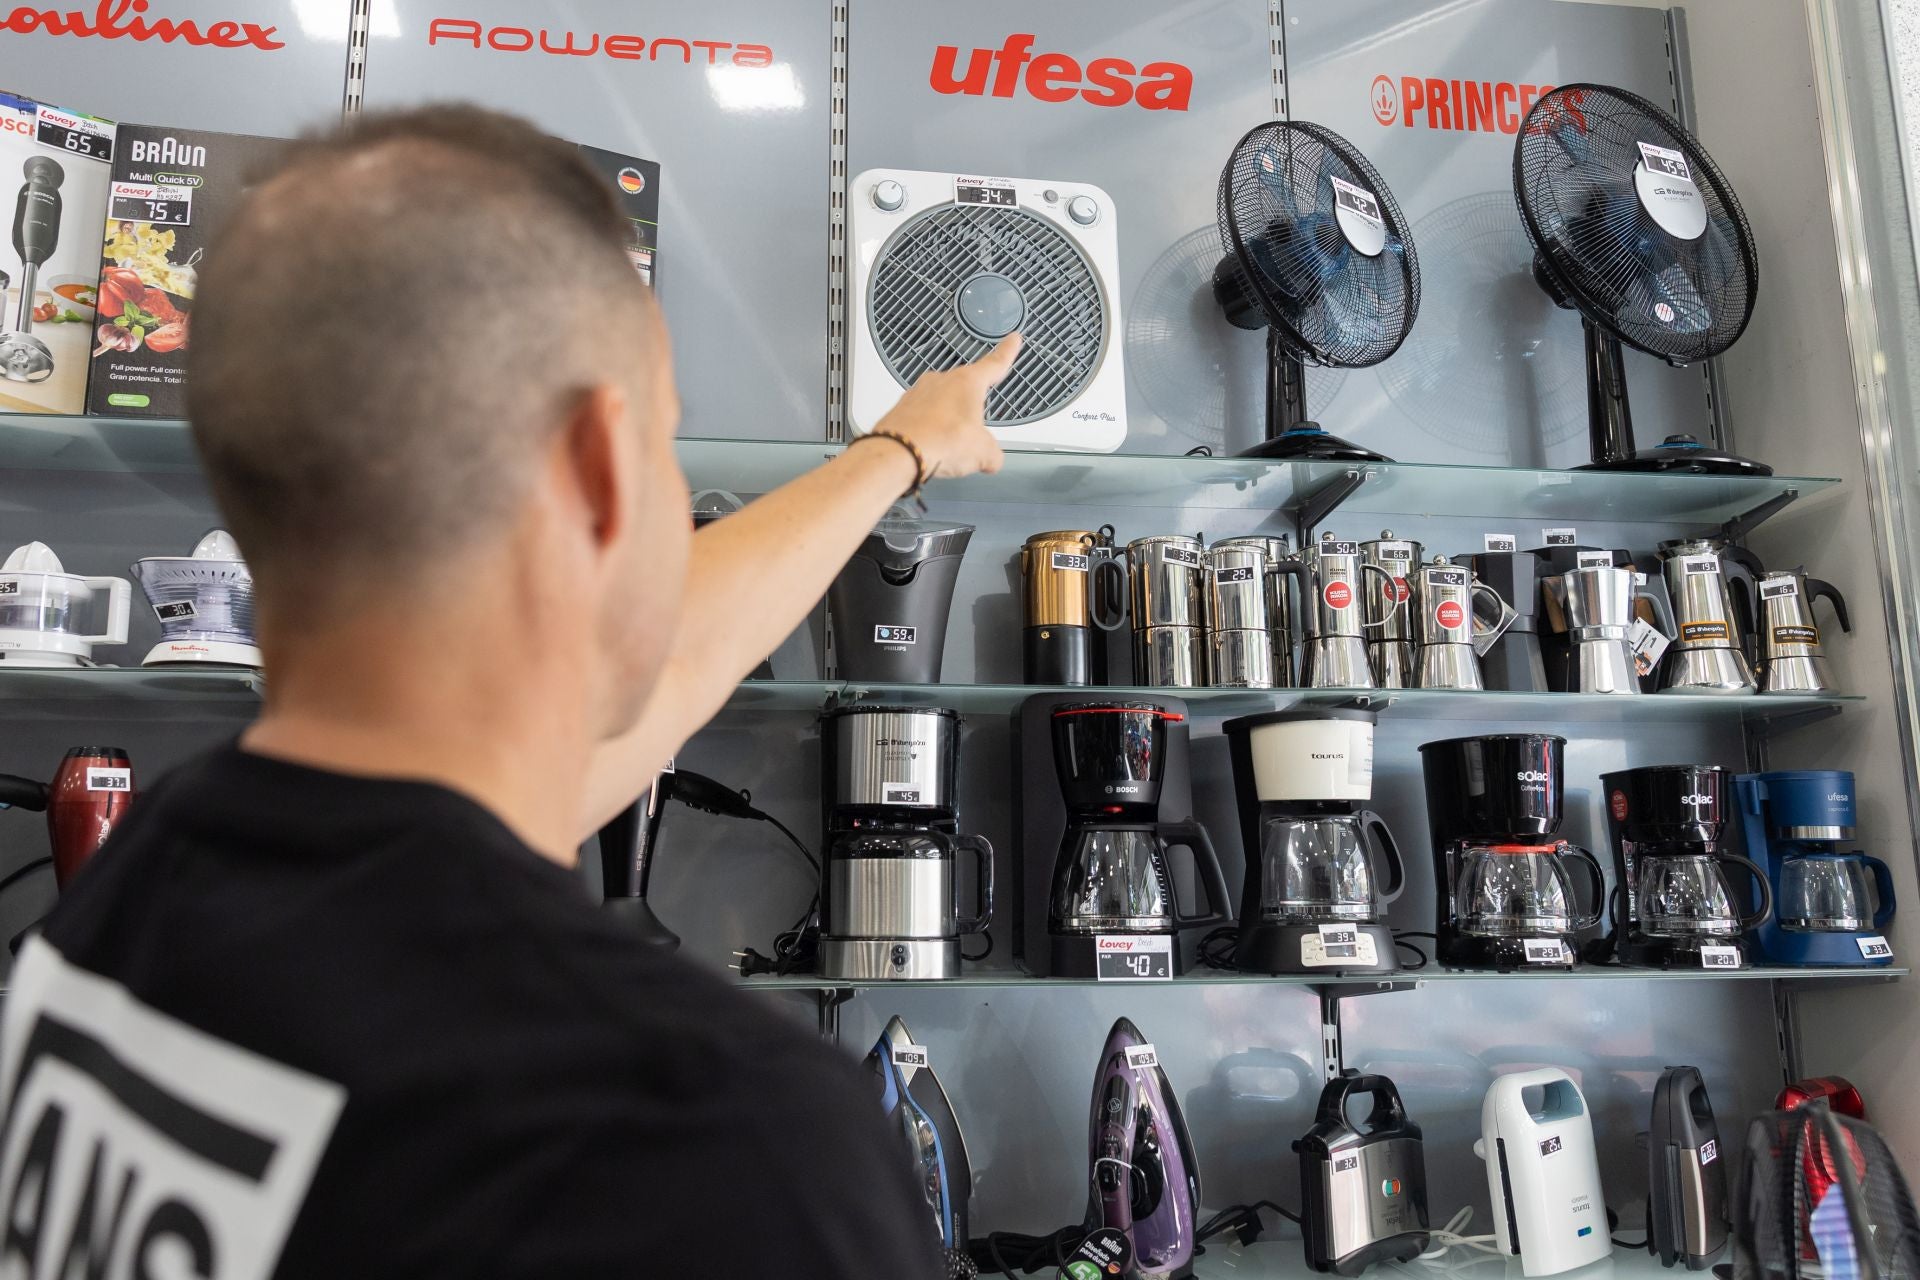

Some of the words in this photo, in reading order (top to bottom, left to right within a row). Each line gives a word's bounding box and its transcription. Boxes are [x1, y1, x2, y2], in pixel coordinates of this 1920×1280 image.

[0, 0, 285, 51] oulinex
[930, 33, 1194, 111] ufesa
[41, 109, 78, 128] Lovey
[65, 131, 92, 154] 65
[132, 137, 207, 167] BRAUN
[1660, 158, 1678, 175] 45
[129, 172, 153, 182] Multi
[157, 174, 185, 185] Quick
[186, 176, 200, 186] 5V
[957, 176, 984, 186] Lovey
[115, 184, 153, 198] Lovey
[981, 188, 1001, 203] 34
[1352, 195, 1368, 214] 42
[145, 201, 168, 221] 75
[110, 363, 124, 371] Full
[163, 376, 182, 384] Total
[1336, 543, 1350, 554] 50
[1393, 550, 1404, 559] 66
[1068, 556, 1081, 567] 33
[1179, 550, 1191, 562] 35
[1702, 563, 1711, 571] 19
[1232, 569, 1246, 581] 29
[1443, 573, 1458, 584] 42
[171, 604, 187, 616] 30
[893, 628, 908, 641] 59
[1311, 752, 1344, 760] taurus
[901, 791, 913, 802] 45
[1827, 791, 1849, 802] ufesa
[1337, 932, 1349, 942] 39
[1098, 938, 1133, 951] Lovey
[1542, 948, 1554, 958] 29
[1126, 954, 1151, 977] 40
[1717, 955, 1729, 965] 20
[904, 1053, 919, 1063] 109
[1344, 1158, 1353, 1169] 32
[1100, 1236, 1123, 1256] BRAUN
